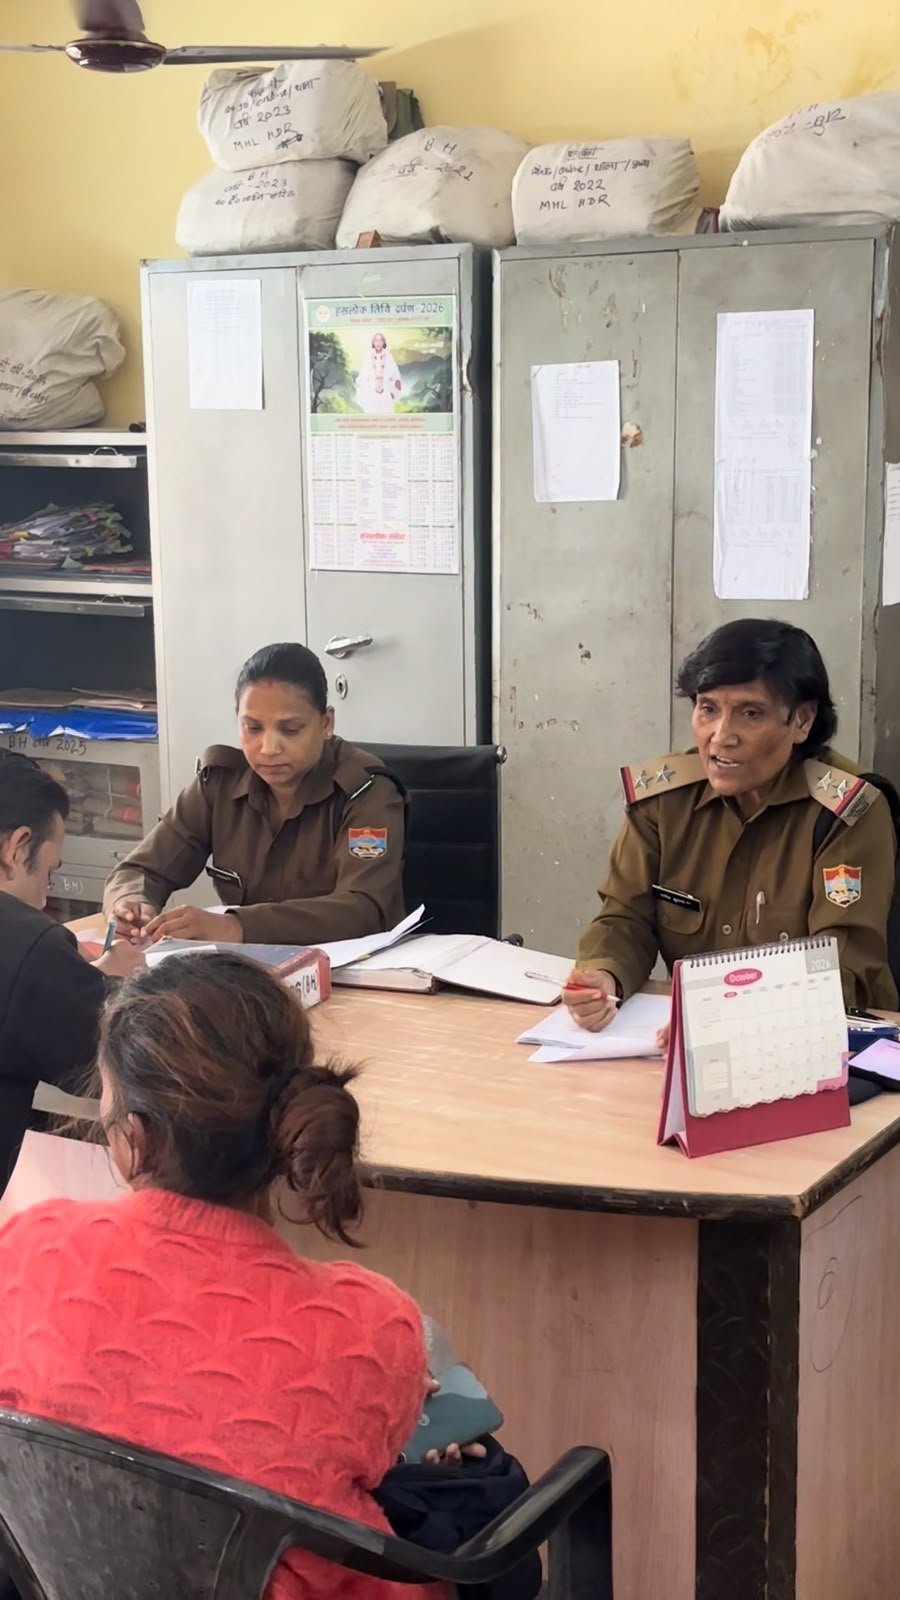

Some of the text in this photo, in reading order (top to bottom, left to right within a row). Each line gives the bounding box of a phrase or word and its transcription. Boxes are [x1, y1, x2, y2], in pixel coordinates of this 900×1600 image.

[257, 105, 291, 122] 2023
[233, 138, 259, 151] MHL
[573, 178, 606, 192] 2022
[539, 194, 611, 211] MHL HDR
[9, 735, 28, 749] BH
[56, 738, 87, 756] 2025
